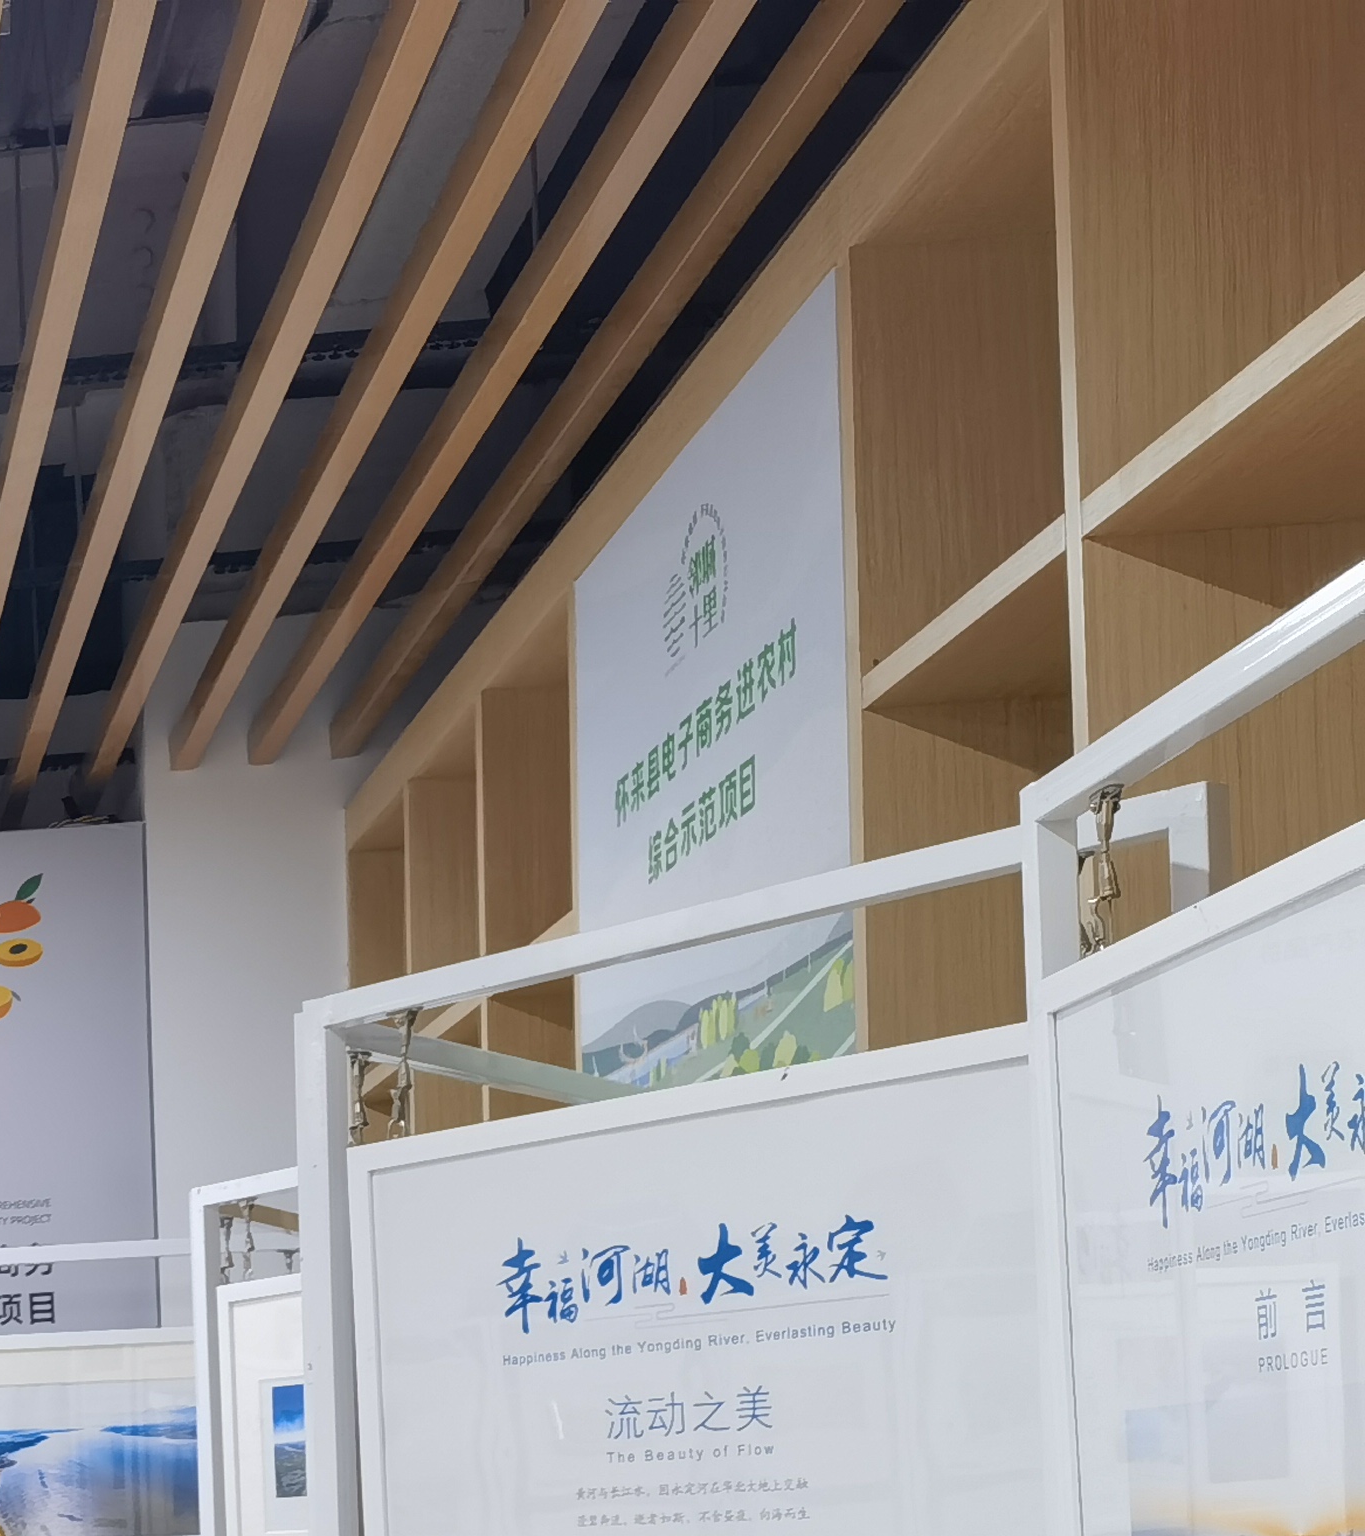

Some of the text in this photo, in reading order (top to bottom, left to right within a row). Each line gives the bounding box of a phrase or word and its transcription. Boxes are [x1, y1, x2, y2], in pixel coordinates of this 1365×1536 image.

[615, 617, 797, 828] 怀来县电子商务进农村
[648, 754, 756, 885] 综合示范项目
[10, 1213, 53, 1225] PROJECT
[1196, 1246, 1221, 1263] Along
[1223, 1240, 1238, 1256] the
[1241, 1230, 1287, 1252] Yongding
[1255, 1279, 1326, 1341] 前言
[502, 1350, 567, 1368] Happiness
[570, 1345, 607, 1363] Along
[611, 1343, 632, 1358] the
[637, 1337, 702, 1354] Yongding
[755, 1323, 835, 1343] Everlasting
[841, 1317, 897, 1336] Beauty
[1258, 1347, 1329, 1374] PROLOGUE
[605, 1385, 773, 1440] 流动之美
[606, 1443, 774, 1464] The Beauty of Flow
